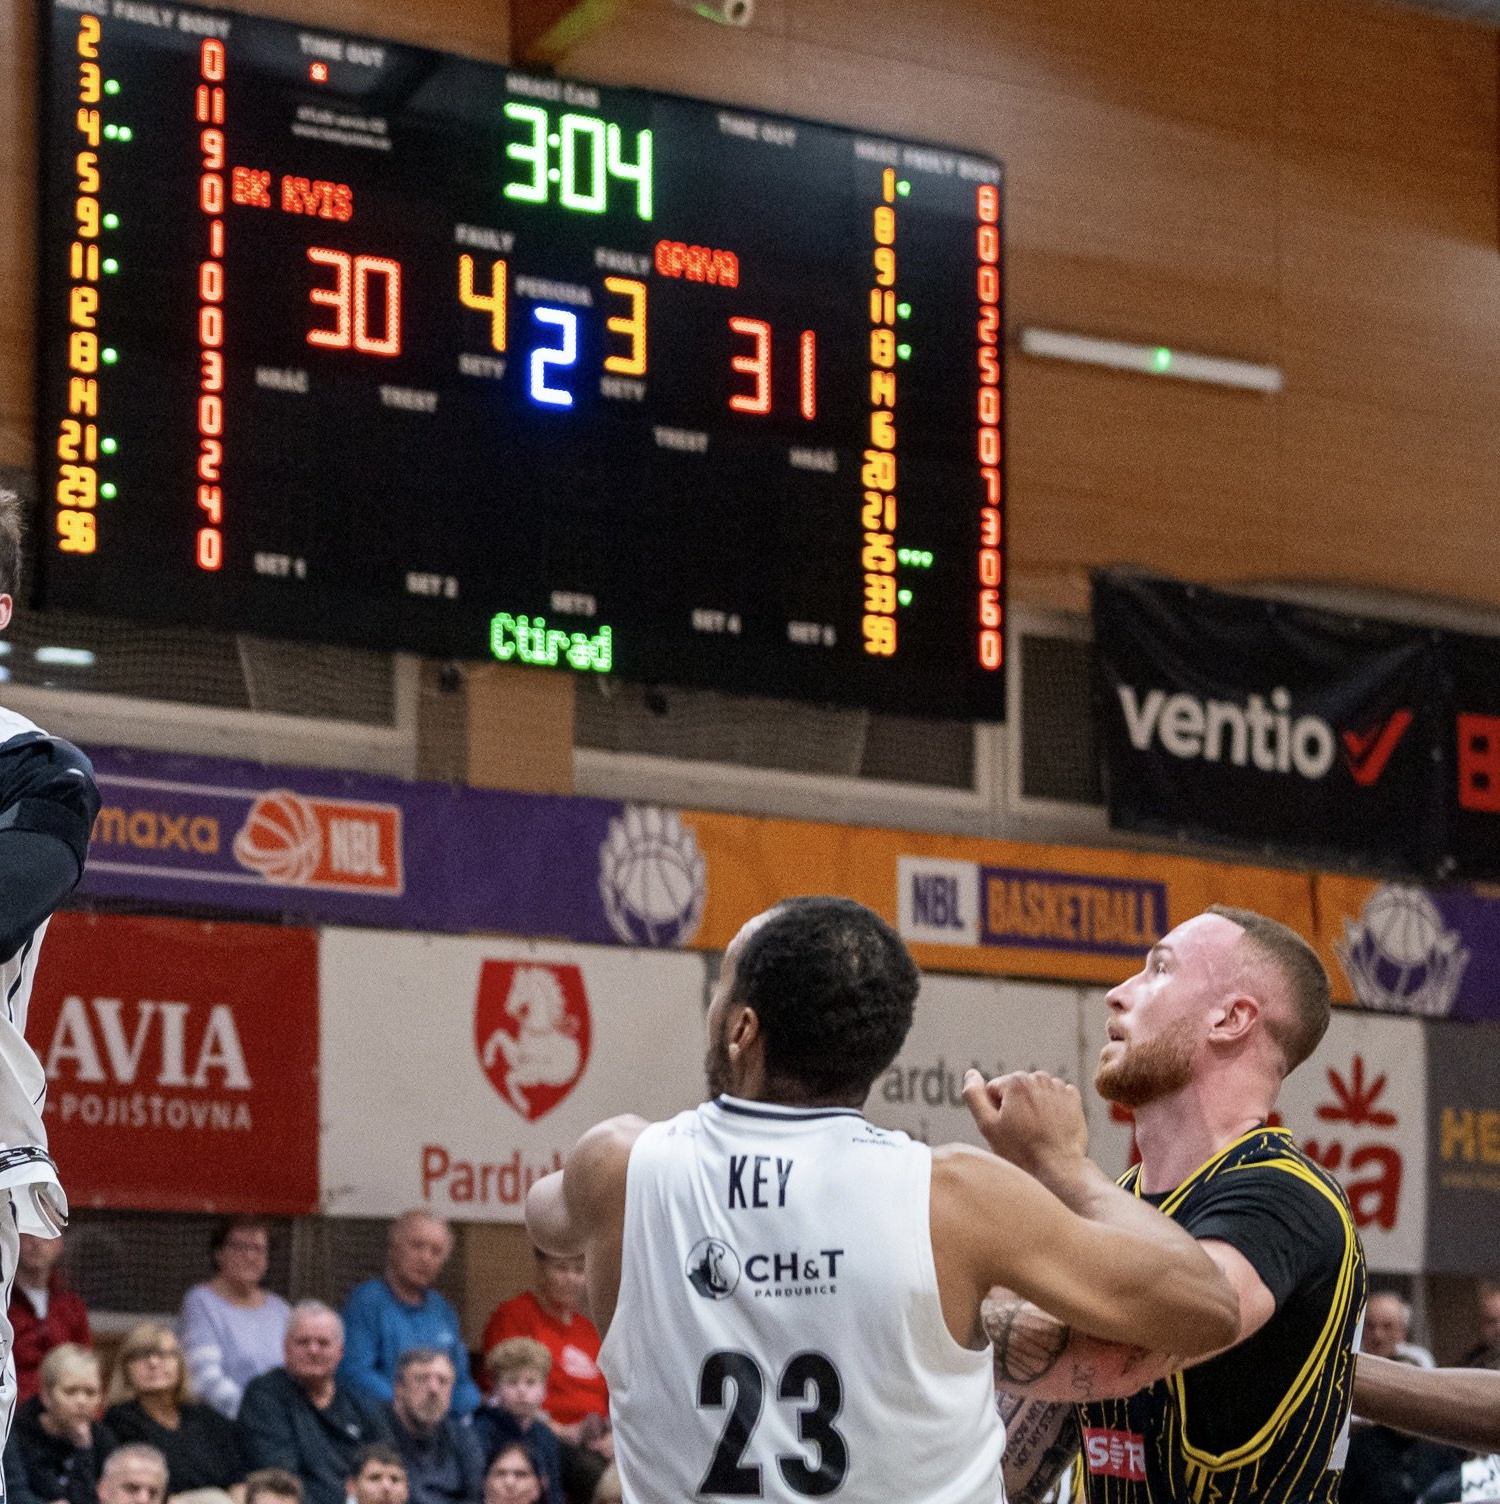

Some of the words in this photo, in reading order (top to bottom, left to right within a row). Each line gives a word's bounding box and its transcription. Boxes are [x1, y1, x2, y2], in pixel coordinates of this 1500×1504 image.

[77, 14, 101, 58] 2
[298, 33, 344, 60] TIME
[346, 42, 384, 67] OUT
[201, 37, 226, 82] 0
[79, 62, 101, 103] 3
[196, 84, 225, 125] 11
[76, 107, 100, 147] 4
[200, 128, 225, 171] 9
[503, 102, 653, 222] 3:04
[76, 151, 99, 193] 5
[232, 166, 270, 208] BK
[281, 174, 353, 220] KVIS
[200, 172, 224, 215] 0
[76, 196, 99, 238] 9
[455, 222, 515, 252] FAULY
[210, 219, 224, 258] 1
[977, 224, 999, 265] 0
[70, 241, 99, 281] 11
[199, 260, 224, 303] 0
[595, 246, 650, 275] FAULY
[655, 239, 739, 289] OPAVA
[306, 246, 401, 357] 30
[459, 254, 507, 352] 4
[977, 265, 1000, 305] 0
[199, 305, 224, 347] 0
[604, 276, 647, 376] 3
[870, 288, 896, 326] 11
[978, 305, 1000, 345] 2
[200, 349, 223, 392] 3
[530, 306, 577, 406] 2
[728, 316, 817, 421] 31
[978, 345, 1000, 386] 5
[198, 394, 223, 437] 0
[978, 385, 1000, 426] 0
[58, 419, 97, 462] 21
[198, 439, 222, 481] 2
[978, 426, 1000, 467] 0
[197, 484, 222, 524] 4
[862, 491, 896, 531] 21
[980, 506, 1001, 548] 3
[197, 527, 222, 571] 0
[254, 552, 290, 577] SET
[979, 547, 1001, 587] 0
[406, 571, 441, 596] SET
[691, 607, 726, 633] SET
[979, 588, 1001, 629] 6
[490, 612, 612, 672] Ctirad
[787, 619, 821, 645] SET
[979, 629, 1002, 671] 0
[1117, 686, 1336, 781] ventio
[91, 806, 220, 855] maxa
[329, 817, 385, 877] NBL
[910, 870, 964, 931] NBL
[987, 877, 1161, 949] BASKETBALL
[43, 995, 252, 1091] AVIA
[728, 1155, 795, 1210] KEY
[745, 1248, 845, 1284] CH&T
[754, 1284, 838, 1299] PARDUBICE
[695, 1346, 851, 1498] 23
